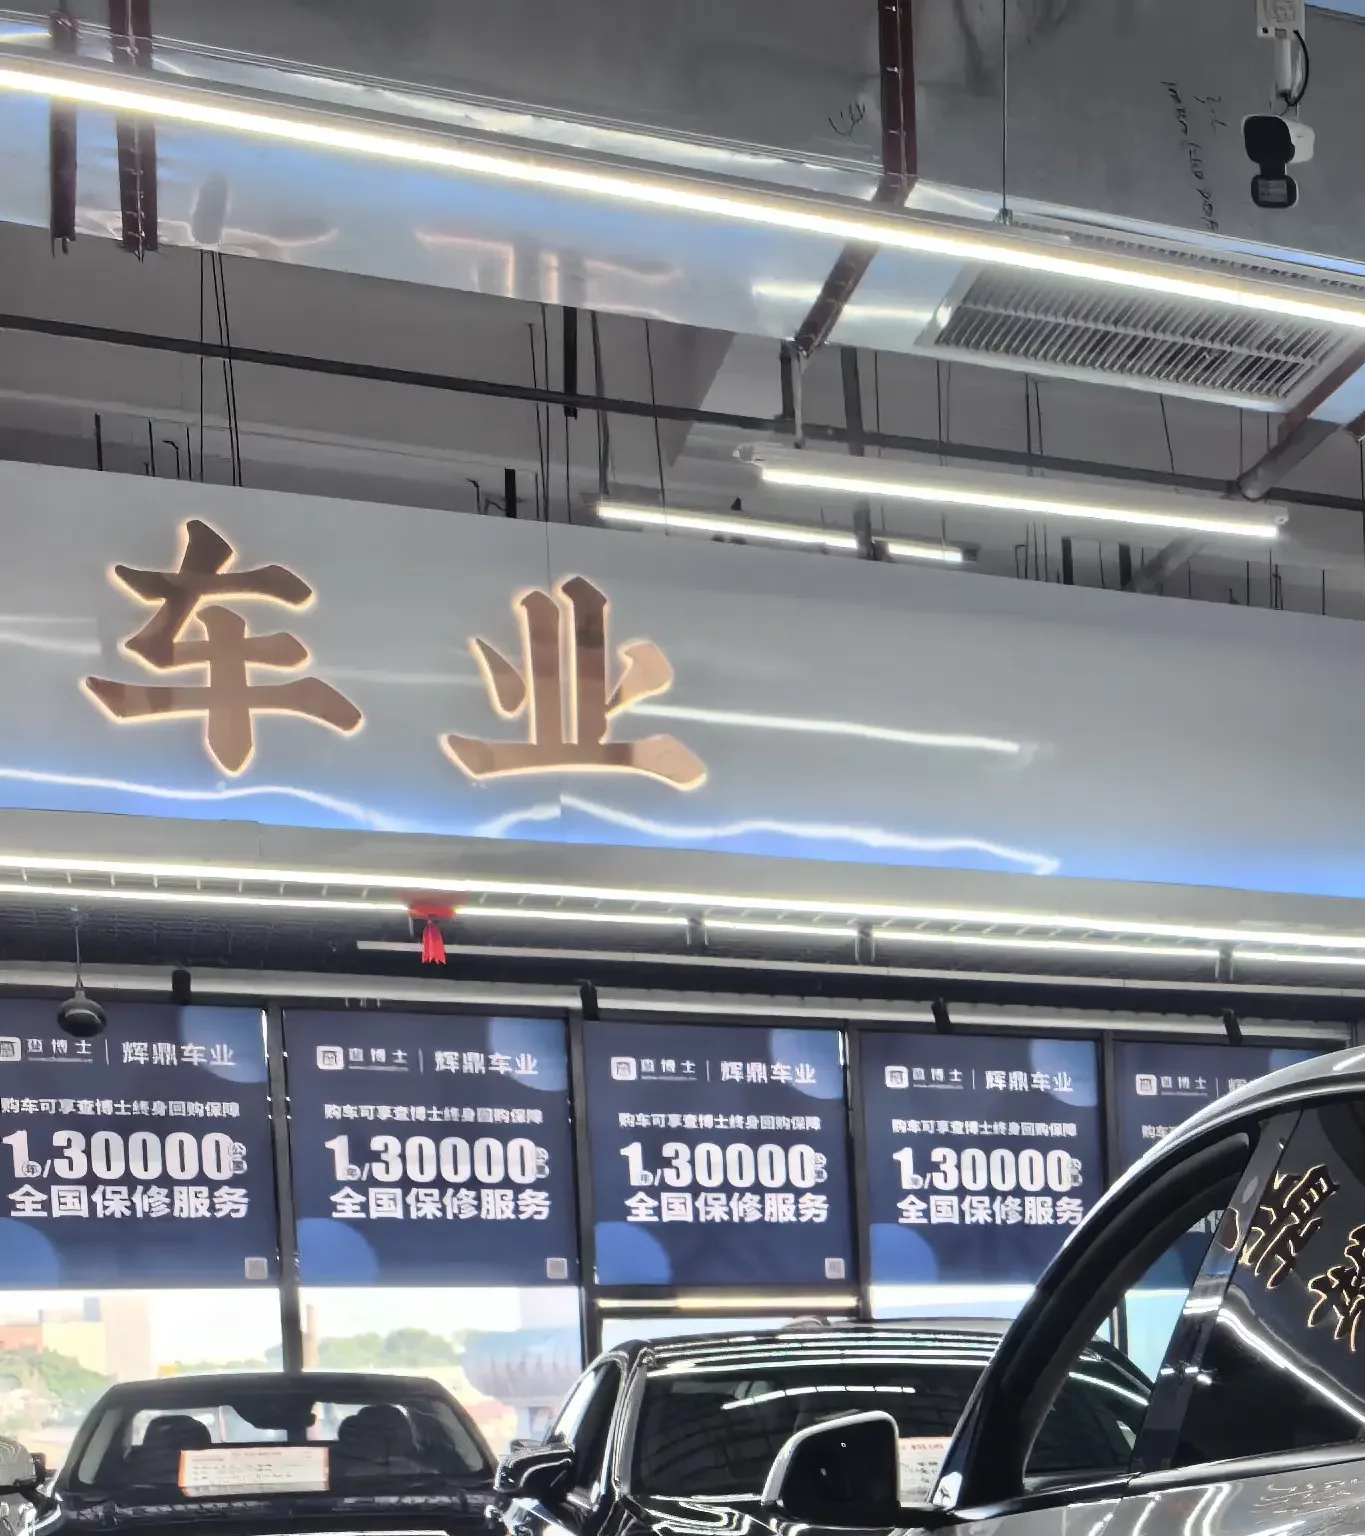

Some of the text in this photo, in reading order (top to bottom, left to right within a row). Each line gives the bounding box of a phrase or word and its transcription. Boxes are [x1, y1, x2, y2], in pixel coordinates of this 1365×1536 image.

[84, 519, 706, 790] 车业
[122, 1042, 236, 1066] 辉鼎车业
[348, 1048, 408, 1064] 博士
[434, 1051, 539, 1075] 辉鼎车业
[640, 1058, 696, 1074] 博士
[720, 1061, 817, 1084] 辉鼎车业
[912, 1067, 963, 1083] 博士
[985, 1070, 1073, 1092] 辉鼎车业
[1160, 1076, 1207, 1090] 博士
[1141, 1124, 1177, 1139] 购车
[8, 1184, 249, 1218] 全国保修服务
[330, 1186, 551, 1220] 全国保修服务
[624, 1191, 829, 1223] 全国保修服务
[896, 1194, 1084, 1225] 全国保修服务
